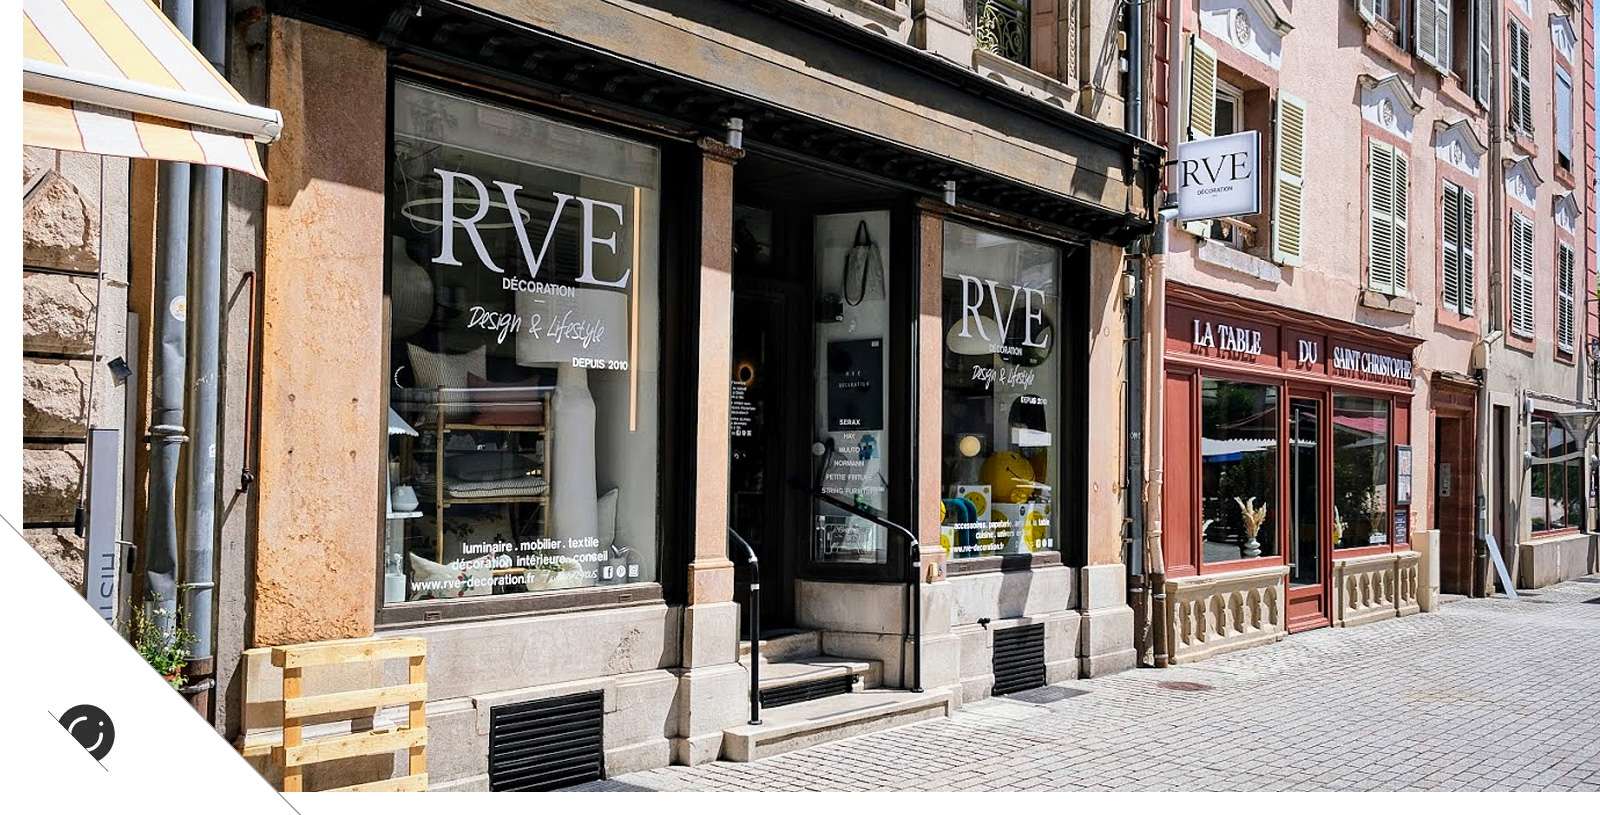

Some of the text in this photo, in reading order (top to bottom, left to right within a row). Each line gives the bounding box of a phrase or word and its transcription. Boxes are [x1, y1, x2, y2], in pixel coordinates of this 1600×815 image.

[1181, 151, 1252, 188] RVE
[1197, 185, 1233, 196] DÉCORATION
[431, 167, 631, 289] RVE
[502, 275, 576, 298] DÉCORATION
[958, 274, 1048, 349] RVE
[467, 305, 605, 349] Design & Lifestyle
[1193, 319, 1412, 380] LA TABLE DU SAINT CHRISTOPHE
[572, 356, 628, 370] DEPUIS 2010
[839, 418, 861, 426] SERAX
[462, 537, 599, 555] luminaire mobilier textile
[451, 550, 608, 571] décoration intérieure conseil
[411, 574, 535, 592] www.rve-decoration.fr
